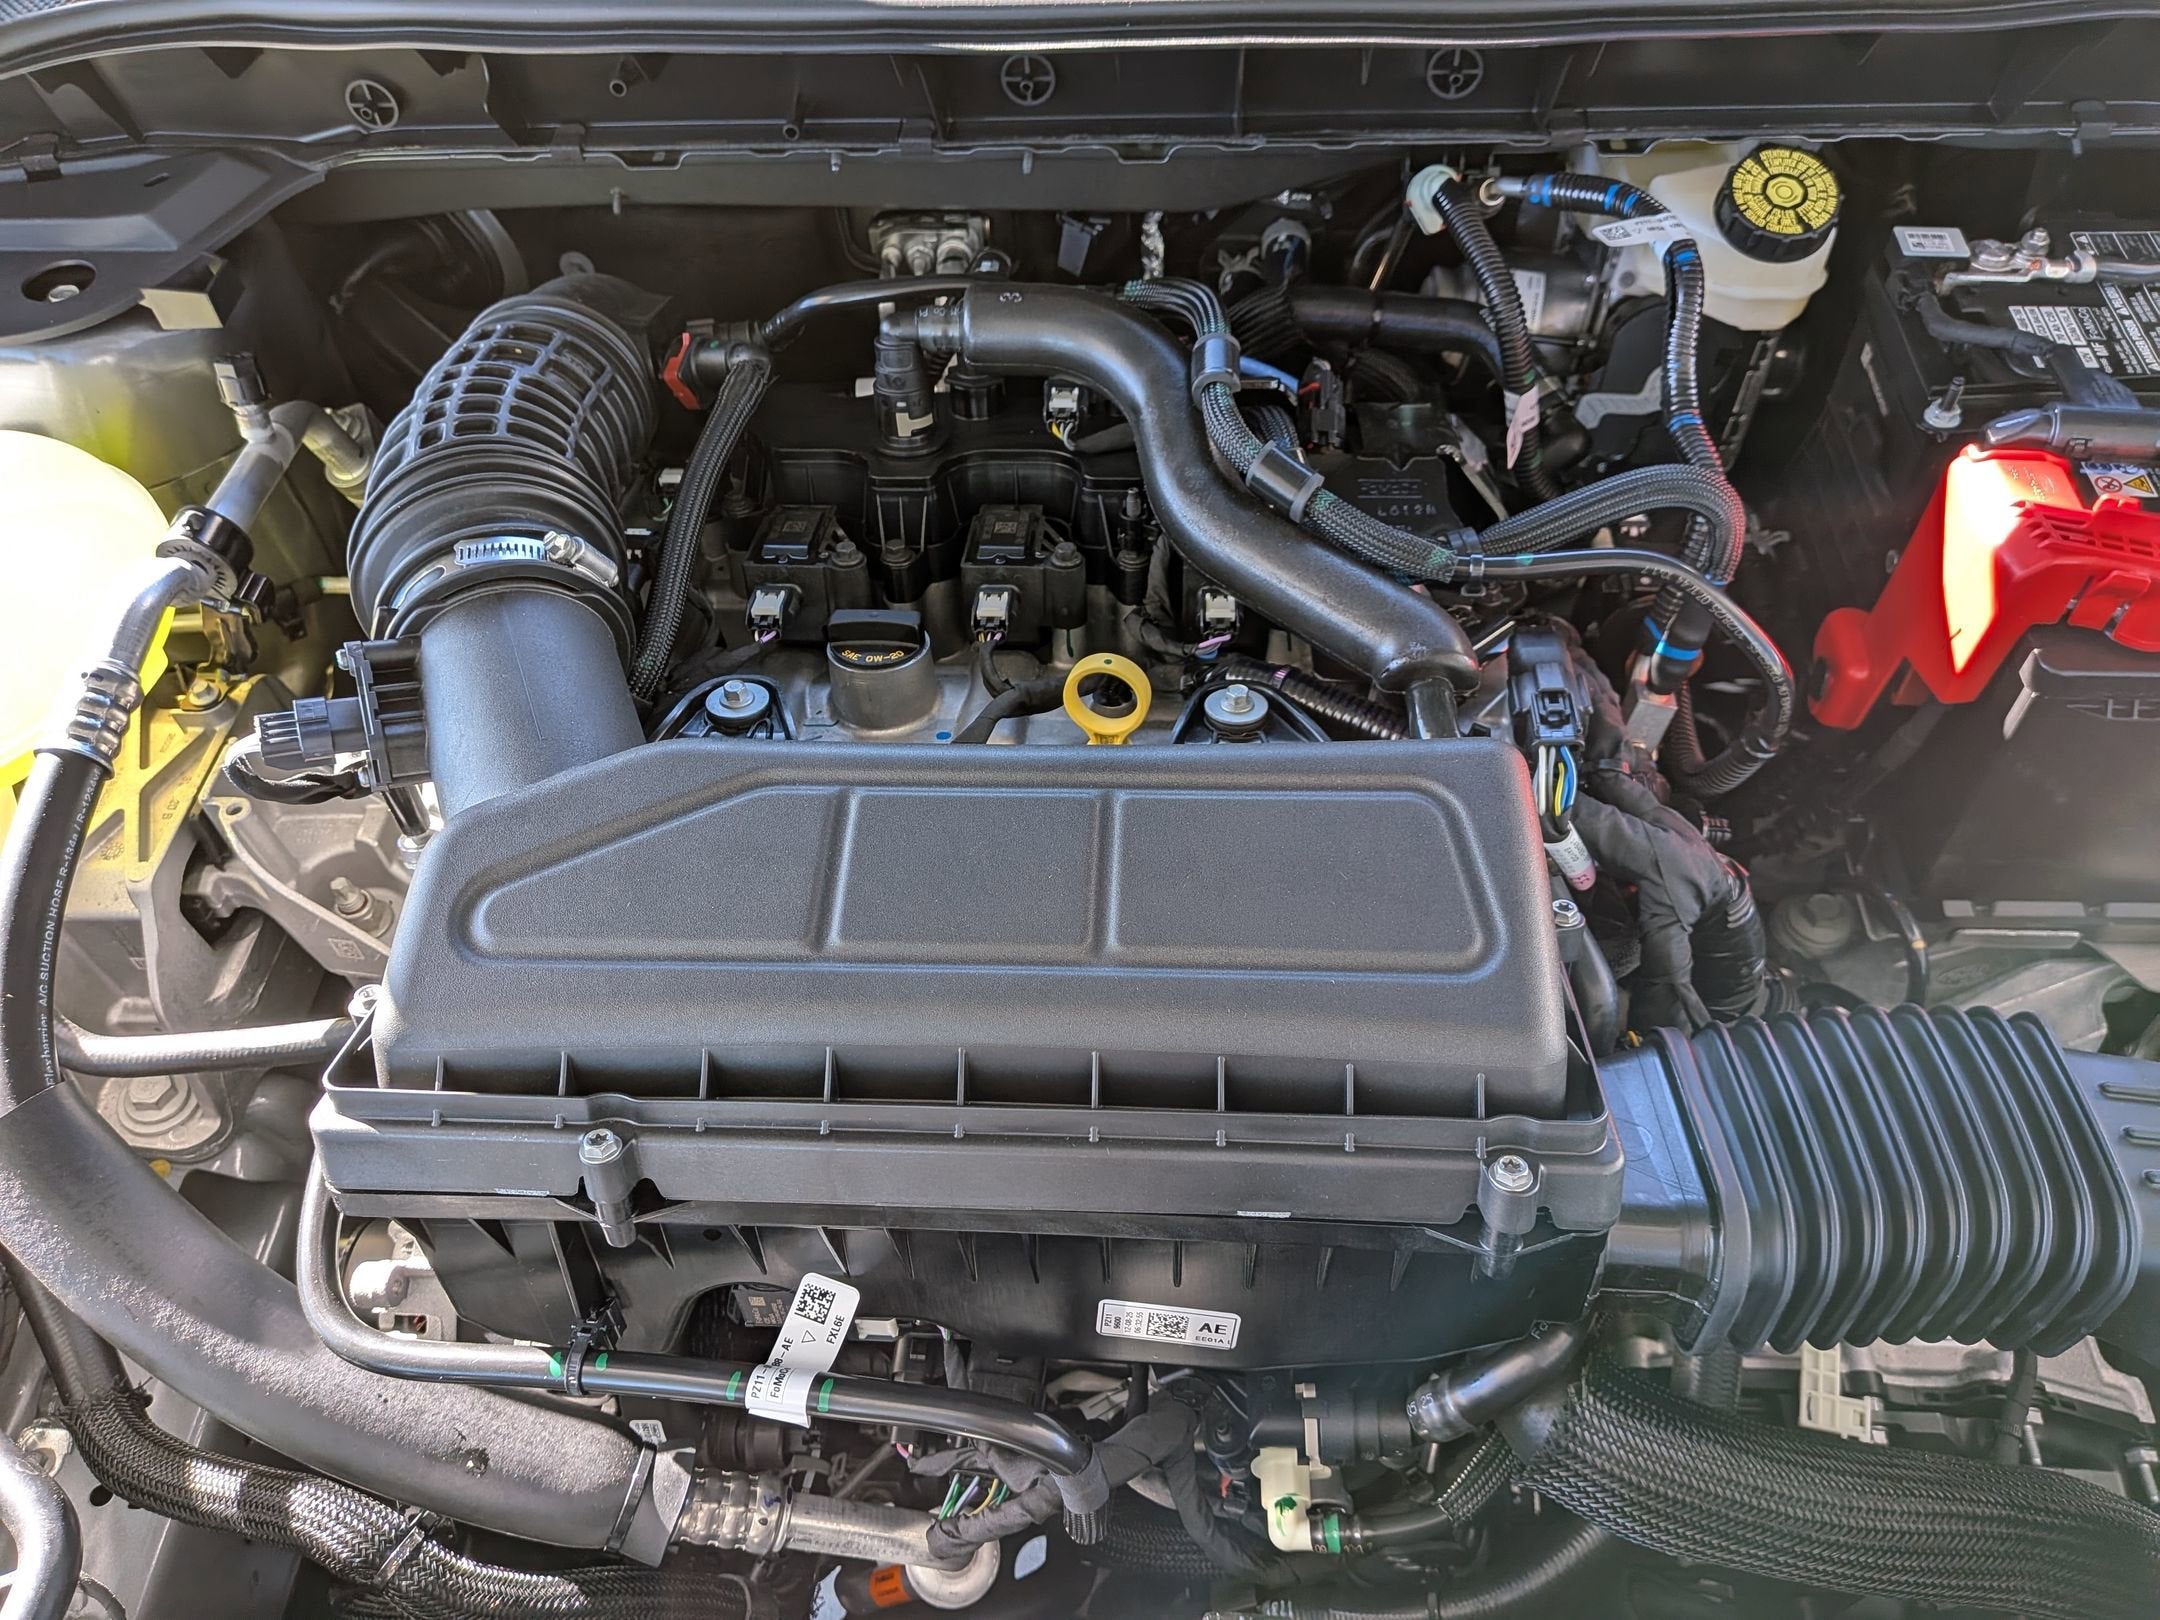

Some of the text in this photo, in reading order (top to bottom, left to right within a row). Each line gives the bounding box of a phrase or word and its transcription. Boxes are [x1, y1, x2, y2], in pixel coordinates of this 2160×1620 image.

[841, 649, 862, 661] SAE
[49, 879, 63, 917] HOSE
[40, 922, 57, 981] SUCTION
[39, 985, 49, 1007] A/C
[826, 1314, 845, 1345] FXL6E
[1104, 1313, 1113, 1327] PZ11
[1198, 1322, 1228, 1336] AE
